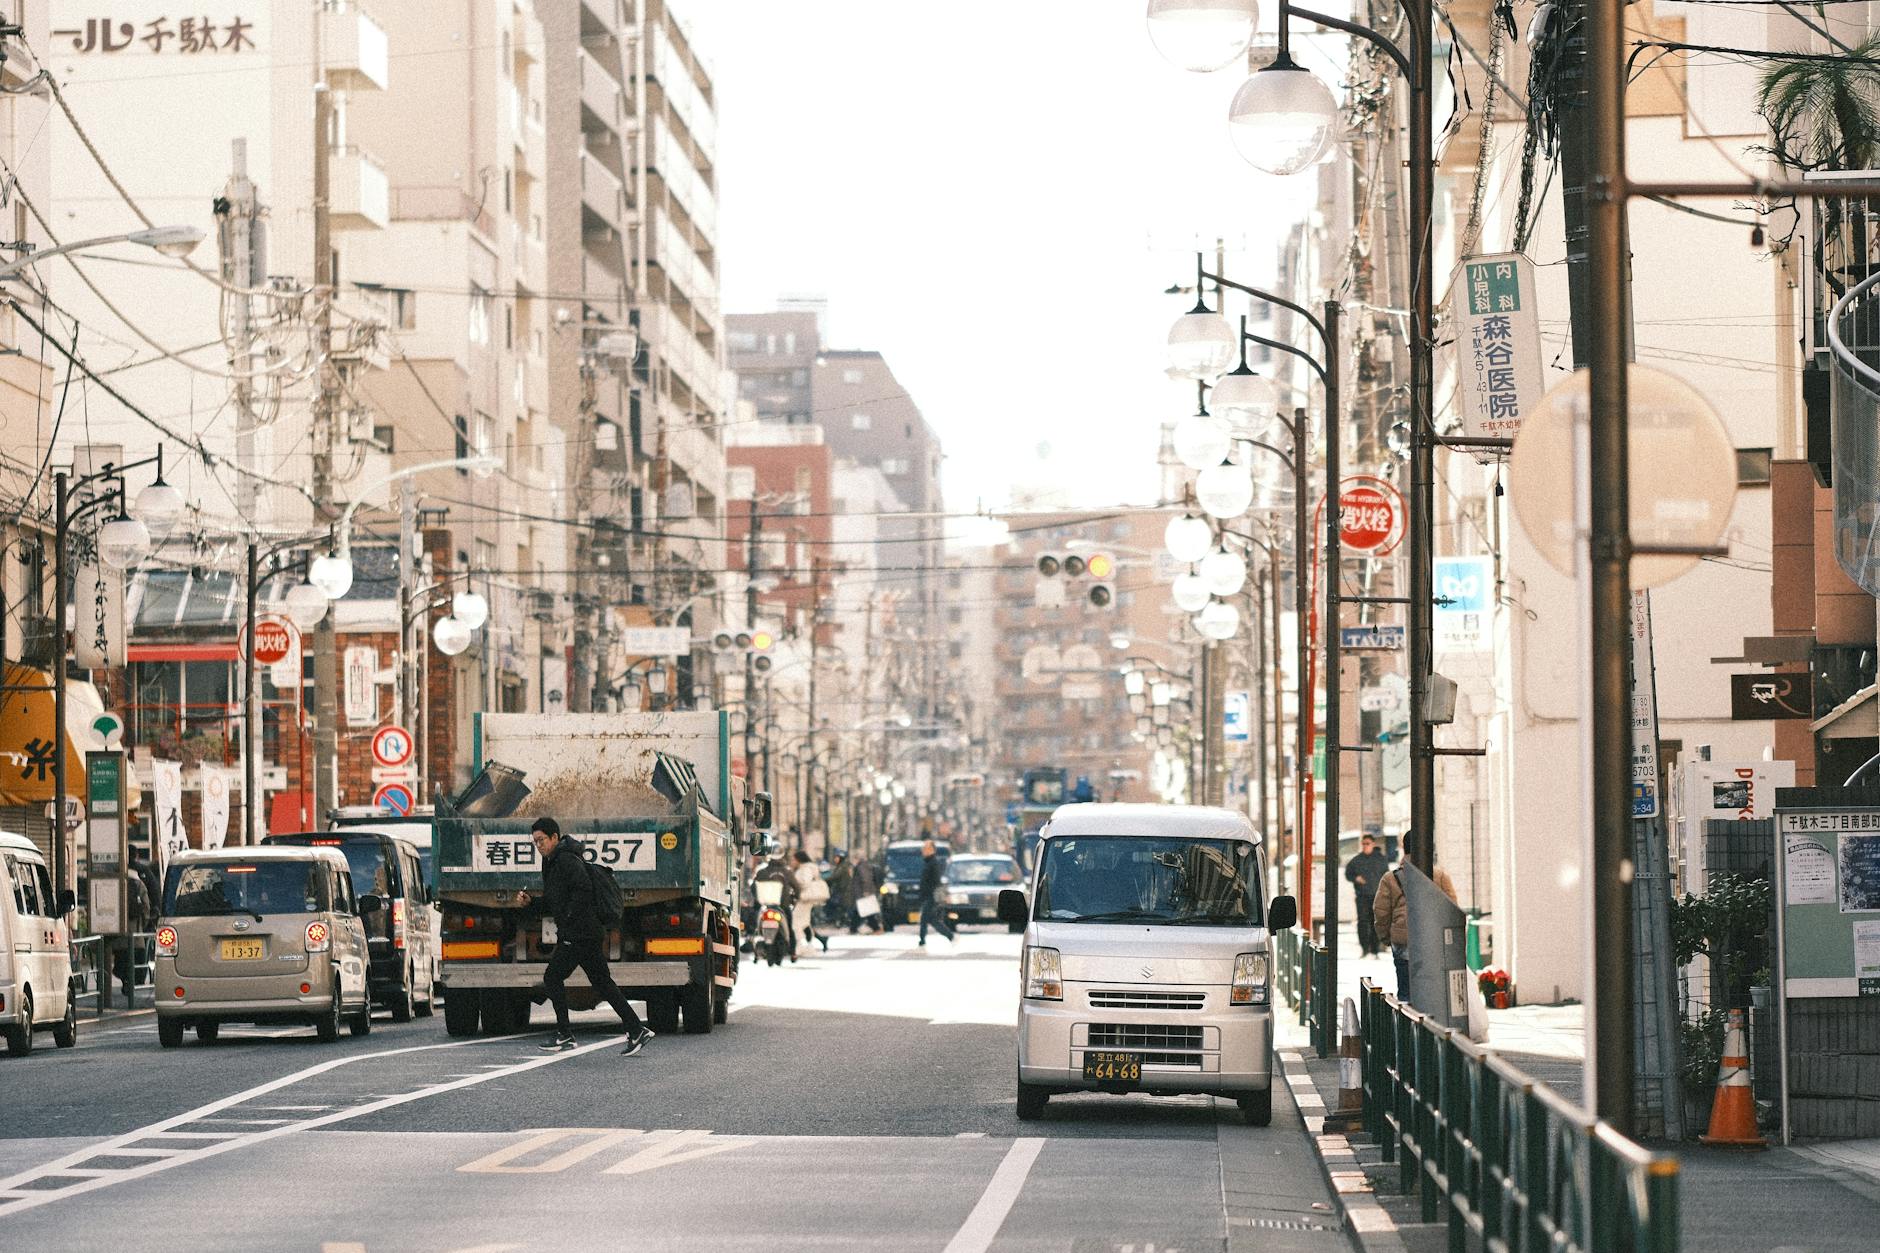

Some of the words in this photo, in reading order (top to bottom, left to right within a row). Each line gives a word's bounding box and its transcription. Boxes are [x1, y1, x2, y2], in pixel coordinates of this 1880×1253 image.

[1473, 265, 1491, 313] 小児科
[1496, 263, 1514, 311] 内科
[1483, 315, 1518, 419] 森谷医院
[1096, 1063, 1138, 1079] 64-68
